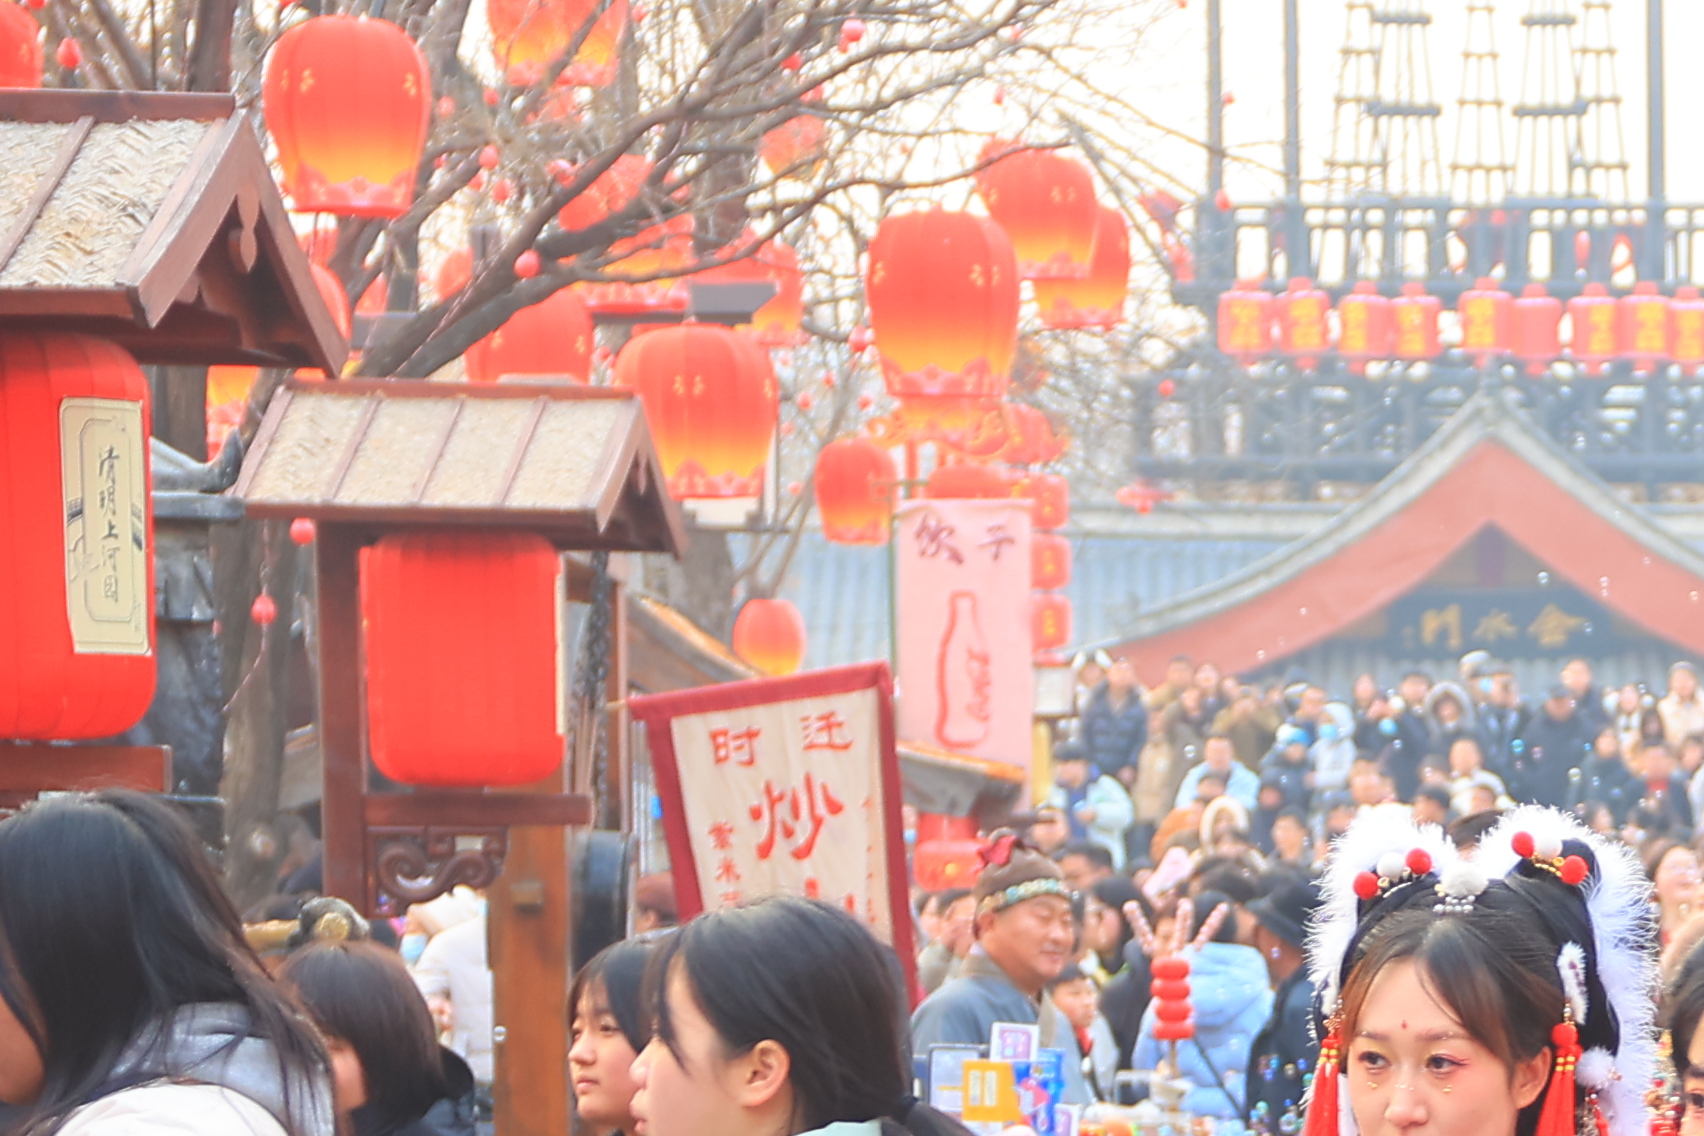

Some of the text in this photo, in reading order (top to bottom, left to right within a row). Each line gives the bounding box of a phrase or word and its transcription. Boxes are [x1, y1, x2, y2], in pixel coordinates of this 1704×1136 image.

[97, 444, 121, 605] 清明上河园
[747, 771, 856, 913] 炒
